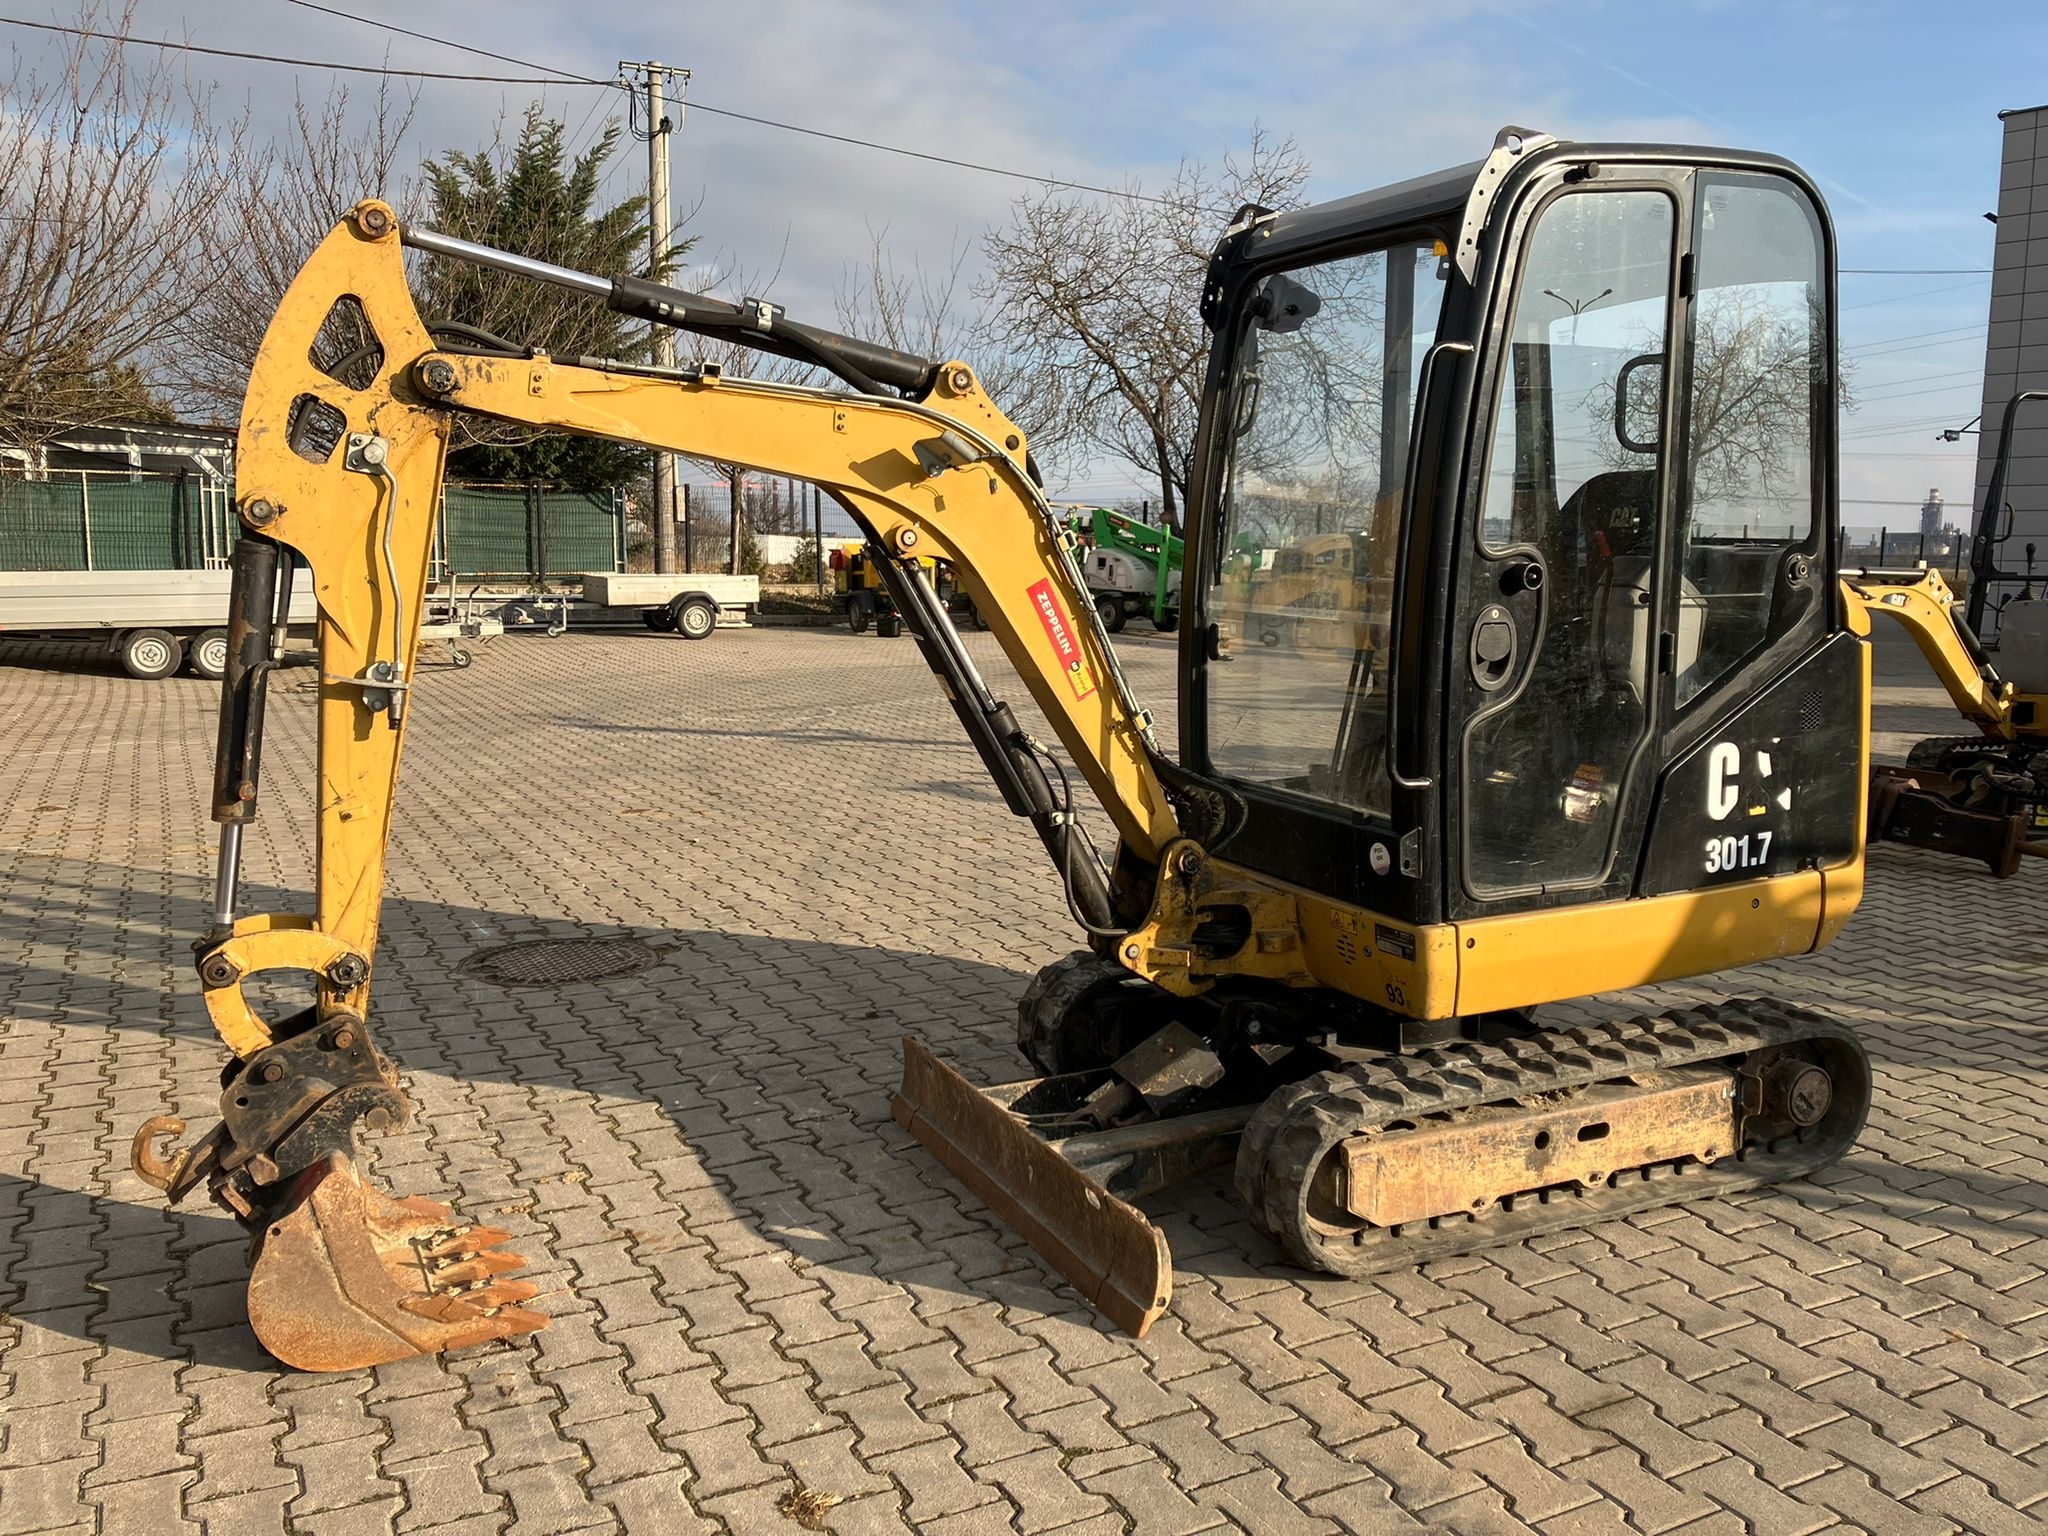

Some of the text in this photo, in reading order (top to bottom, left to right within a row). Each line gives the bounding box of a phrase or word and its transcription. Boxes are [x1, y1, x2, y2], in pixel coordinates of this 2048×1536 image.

[1609, 506, 1639, 528] CAT
[1037, 591, 1072, 655] ZEPPELIN
[1705, 831, 1772, 873] 301.7
[1386, 983, 1405, 1006] 93
